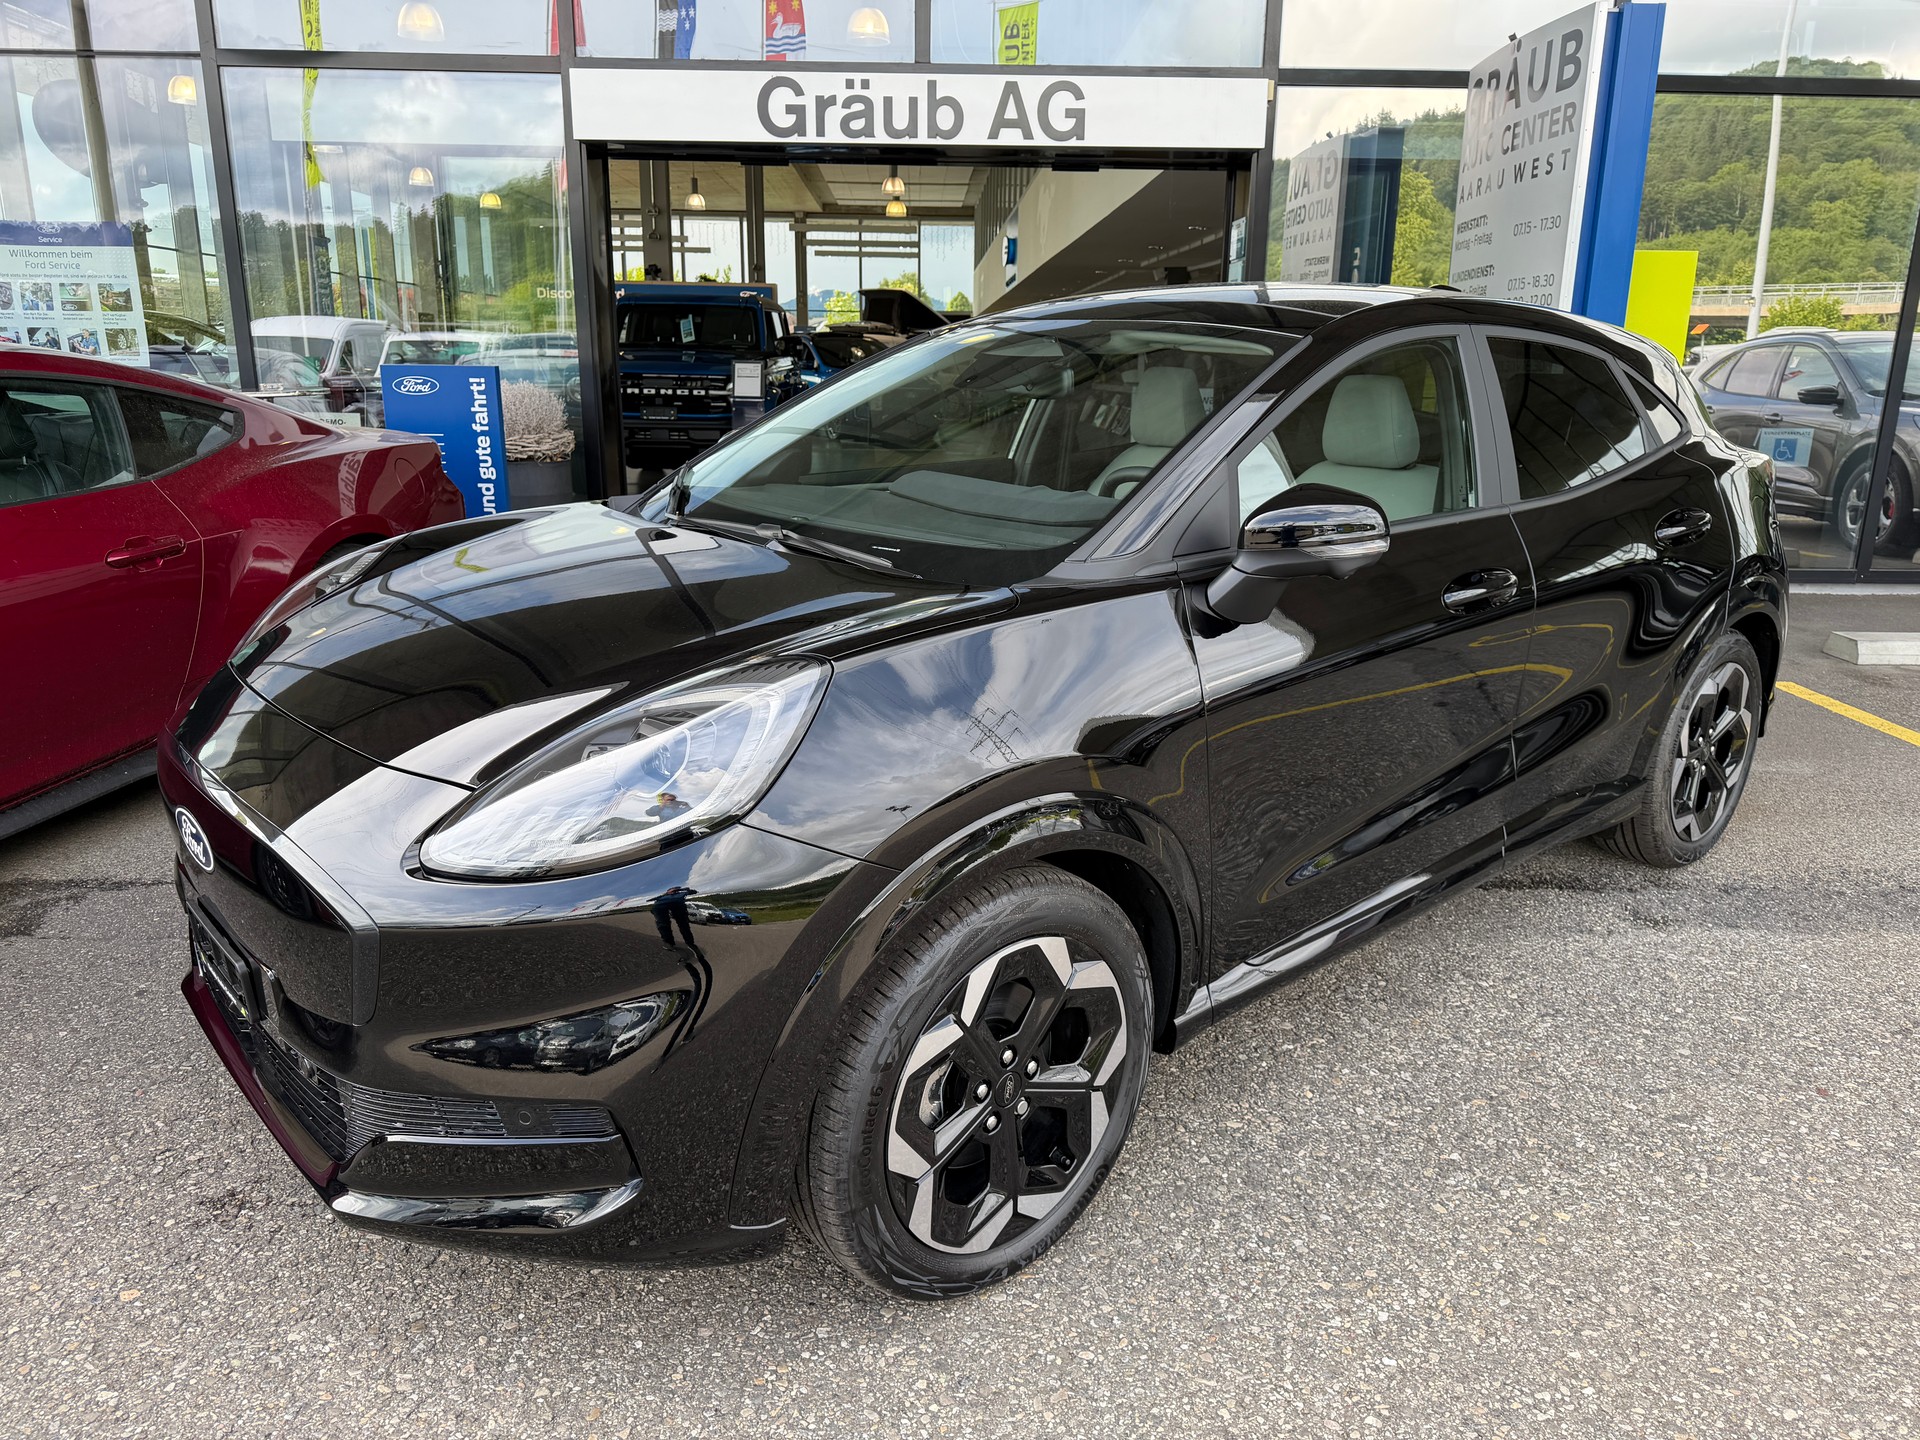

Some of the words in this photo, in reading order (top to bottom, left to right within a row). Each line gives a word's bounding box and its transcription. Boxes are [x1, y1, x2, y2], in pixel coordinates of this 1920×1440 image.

[757, 76, 964, 140] Gräub
[987, 80, 1086, 141] AG
[1501, 101, 1577, 156] CENTER
[1459, 168, 1505, 204] AARAU
[1514, 148, 1571, 184] WEST
[1457, 214, 1488, 234] WERKSTATT:
[1513, 221, 1532, 237] 07.15
[1540, 215, 1561, 231] 17.30
[9, 249, 68, 259] Willkommen
[70, 249, 93, 259] beim
[25, 261, 46, 269] Ford
[48, 261, 80, 270] Service
[537, 287, 574, 299] Disco
[1507, 277, 1526, 292] 07.15
[1532, 273, 1555, 288] 18.30
[1530, 293, 1553, 306] 1200
[400, 378, 431, 393] Ford
[469, 377, 489, 432] fahrt!
[476, 436, 497, 480] gute
[181, 815, 206, 863] Ford
